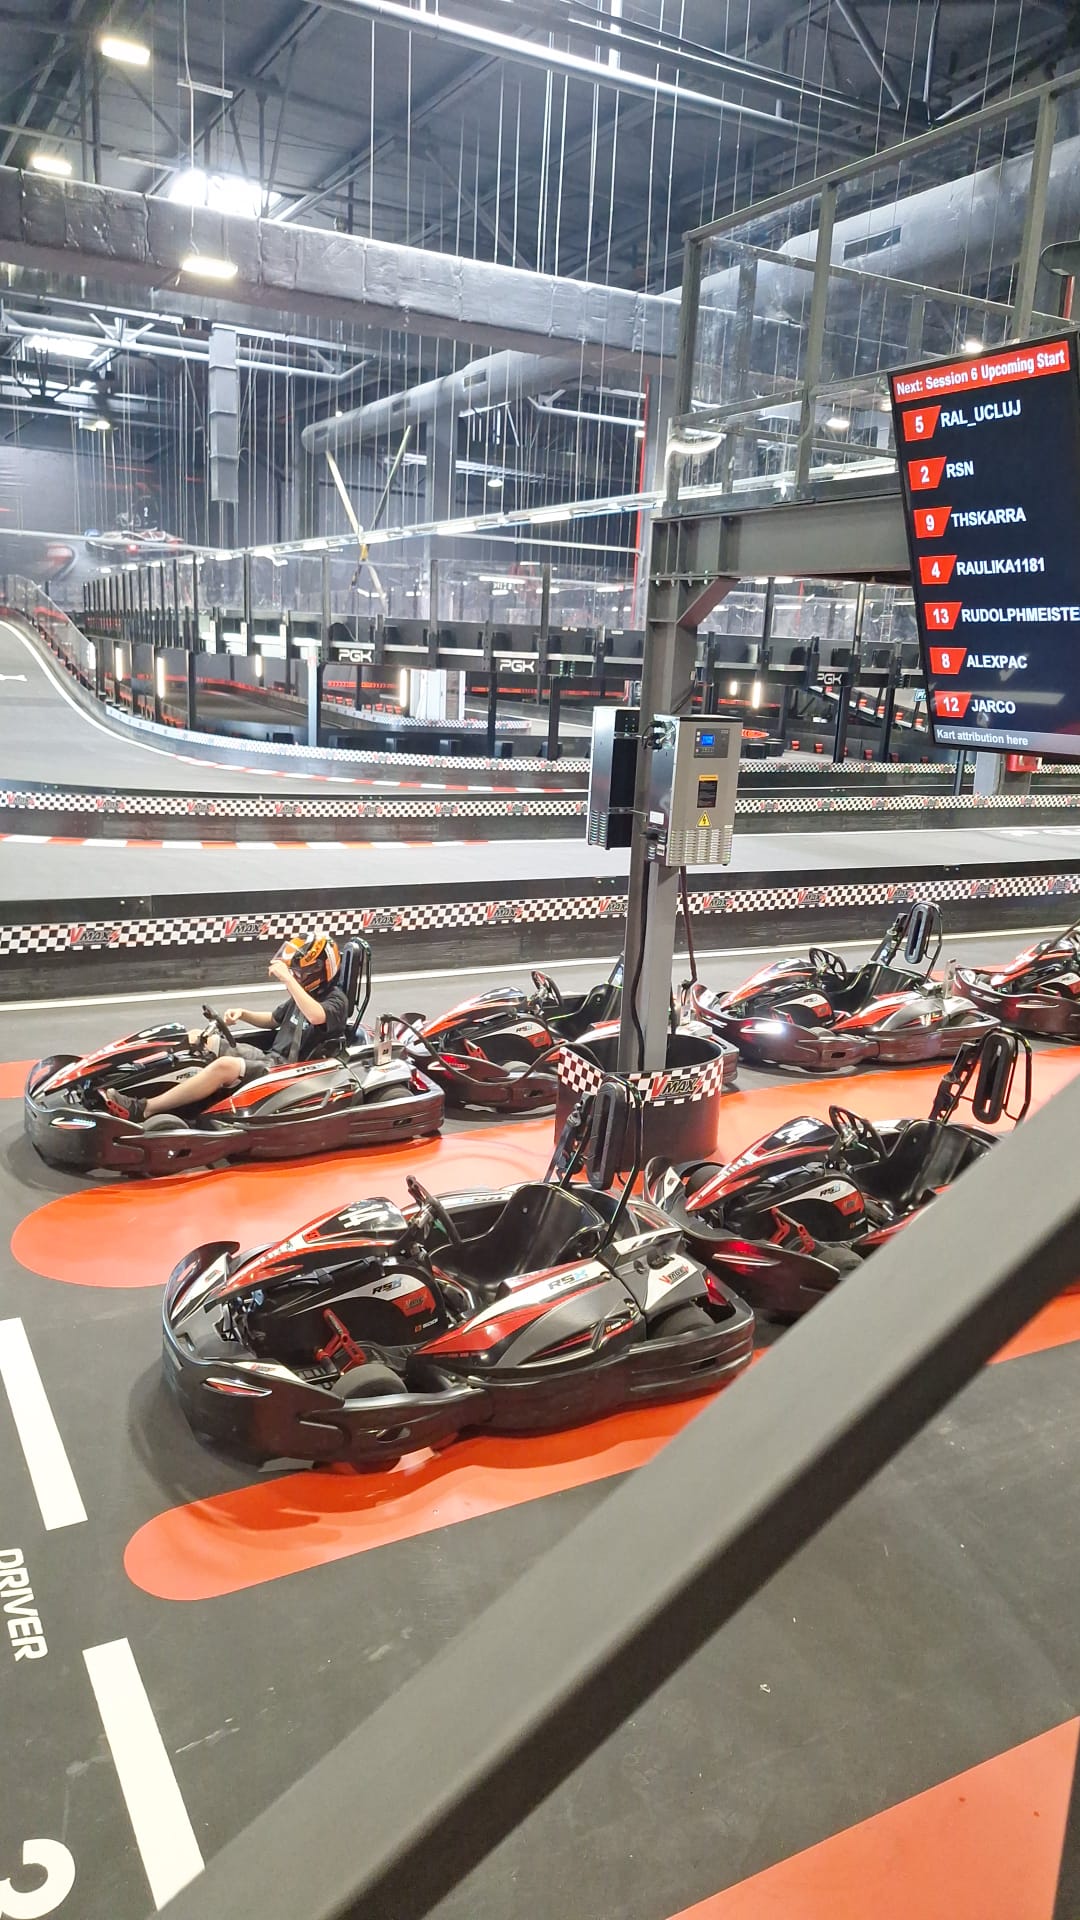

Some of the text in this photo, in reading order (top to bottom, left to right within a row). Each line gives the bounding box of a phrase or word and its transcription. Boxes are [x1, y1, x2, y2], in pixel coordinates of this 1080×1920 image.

[896, 350, 1065, 396] Next: Session 6 Upcoming Start
[915, 400, 1021, 433] 5 RAL_UCLUJ
[920, 461, 974, 484] 2 RSN
[925, 507, 1026, 532] 9 THSKARRA
[931, 557, 1045, 579] 4 RAULIKA1181
[932, 606, 1080, 624] 13 RUDOLPHMEISTE
[338, 649, 372, 663] PGK
[941, 653, 1028, 670] 8 ALEXPAC
[499, 659, 535, 673] PGK
[943, 697, 1016, 714] 12 JARCO
[936, 729, 1029, 746] Kart attribution here
[363, 912, 396, 928] VMAX
[486, 904, 517, 920] VMAX
[69, 927, 112, 944] VMAX
[224, 919, 261, 937] VMAX
[651, 1075, 698, 1098] VMAX
[547, 1269, 588, 1290] RSX
[0, 1547, 48, 1662] DRIVER
